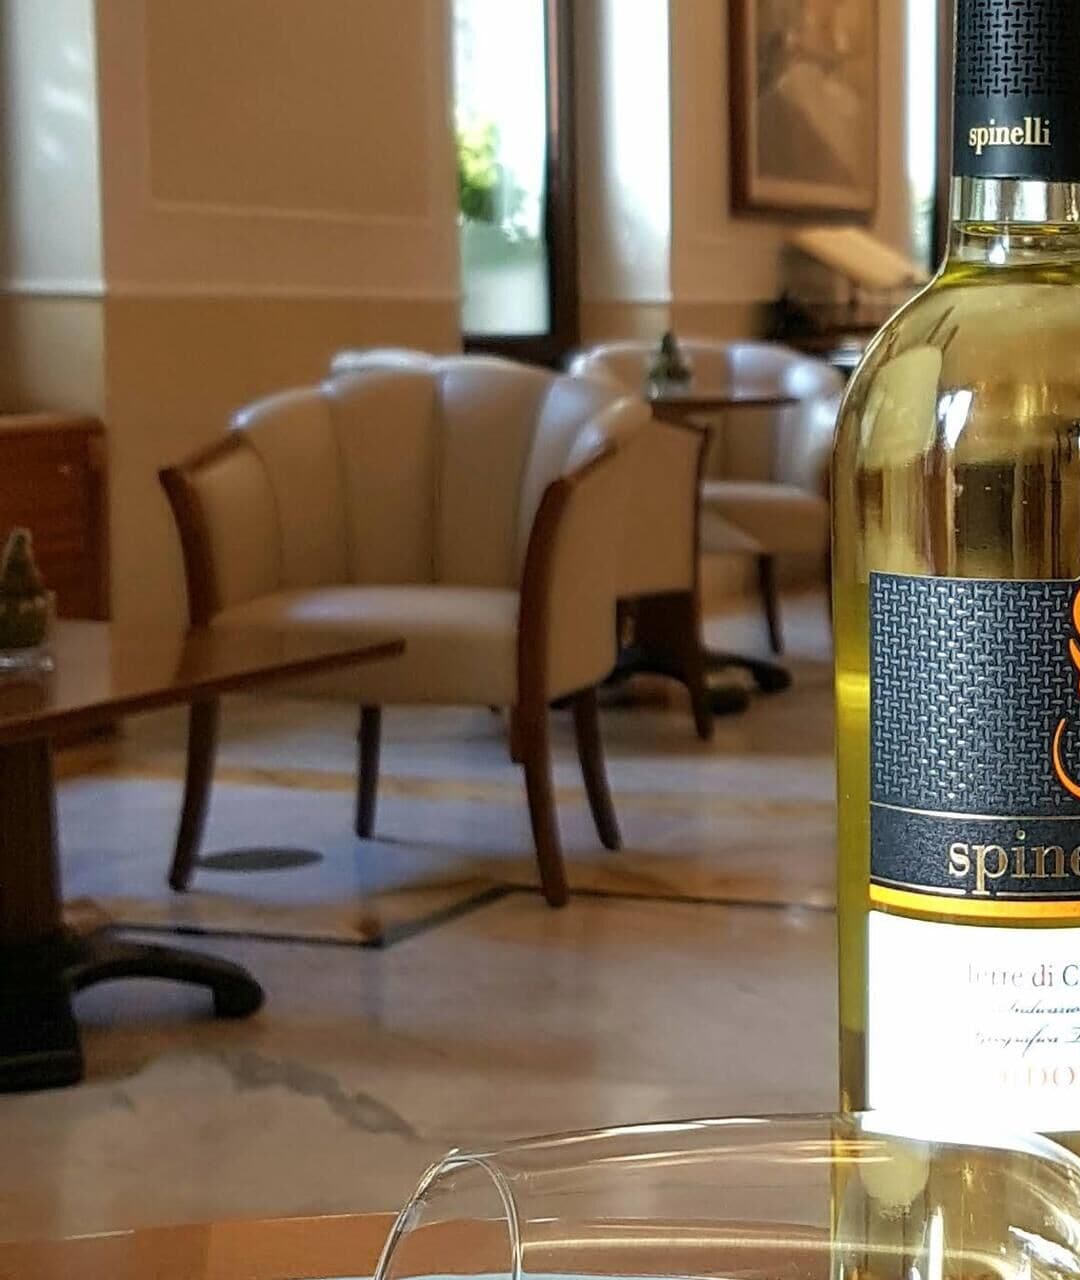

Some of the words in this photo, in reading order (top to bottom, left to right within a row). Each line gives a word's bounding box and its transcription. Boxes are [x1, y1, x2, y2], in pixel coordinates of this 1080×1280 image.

[968, 116, 1052, 156] spinelli
[967, 962, 1024, 987] rre
[1031, 963, 1054, 988] di
